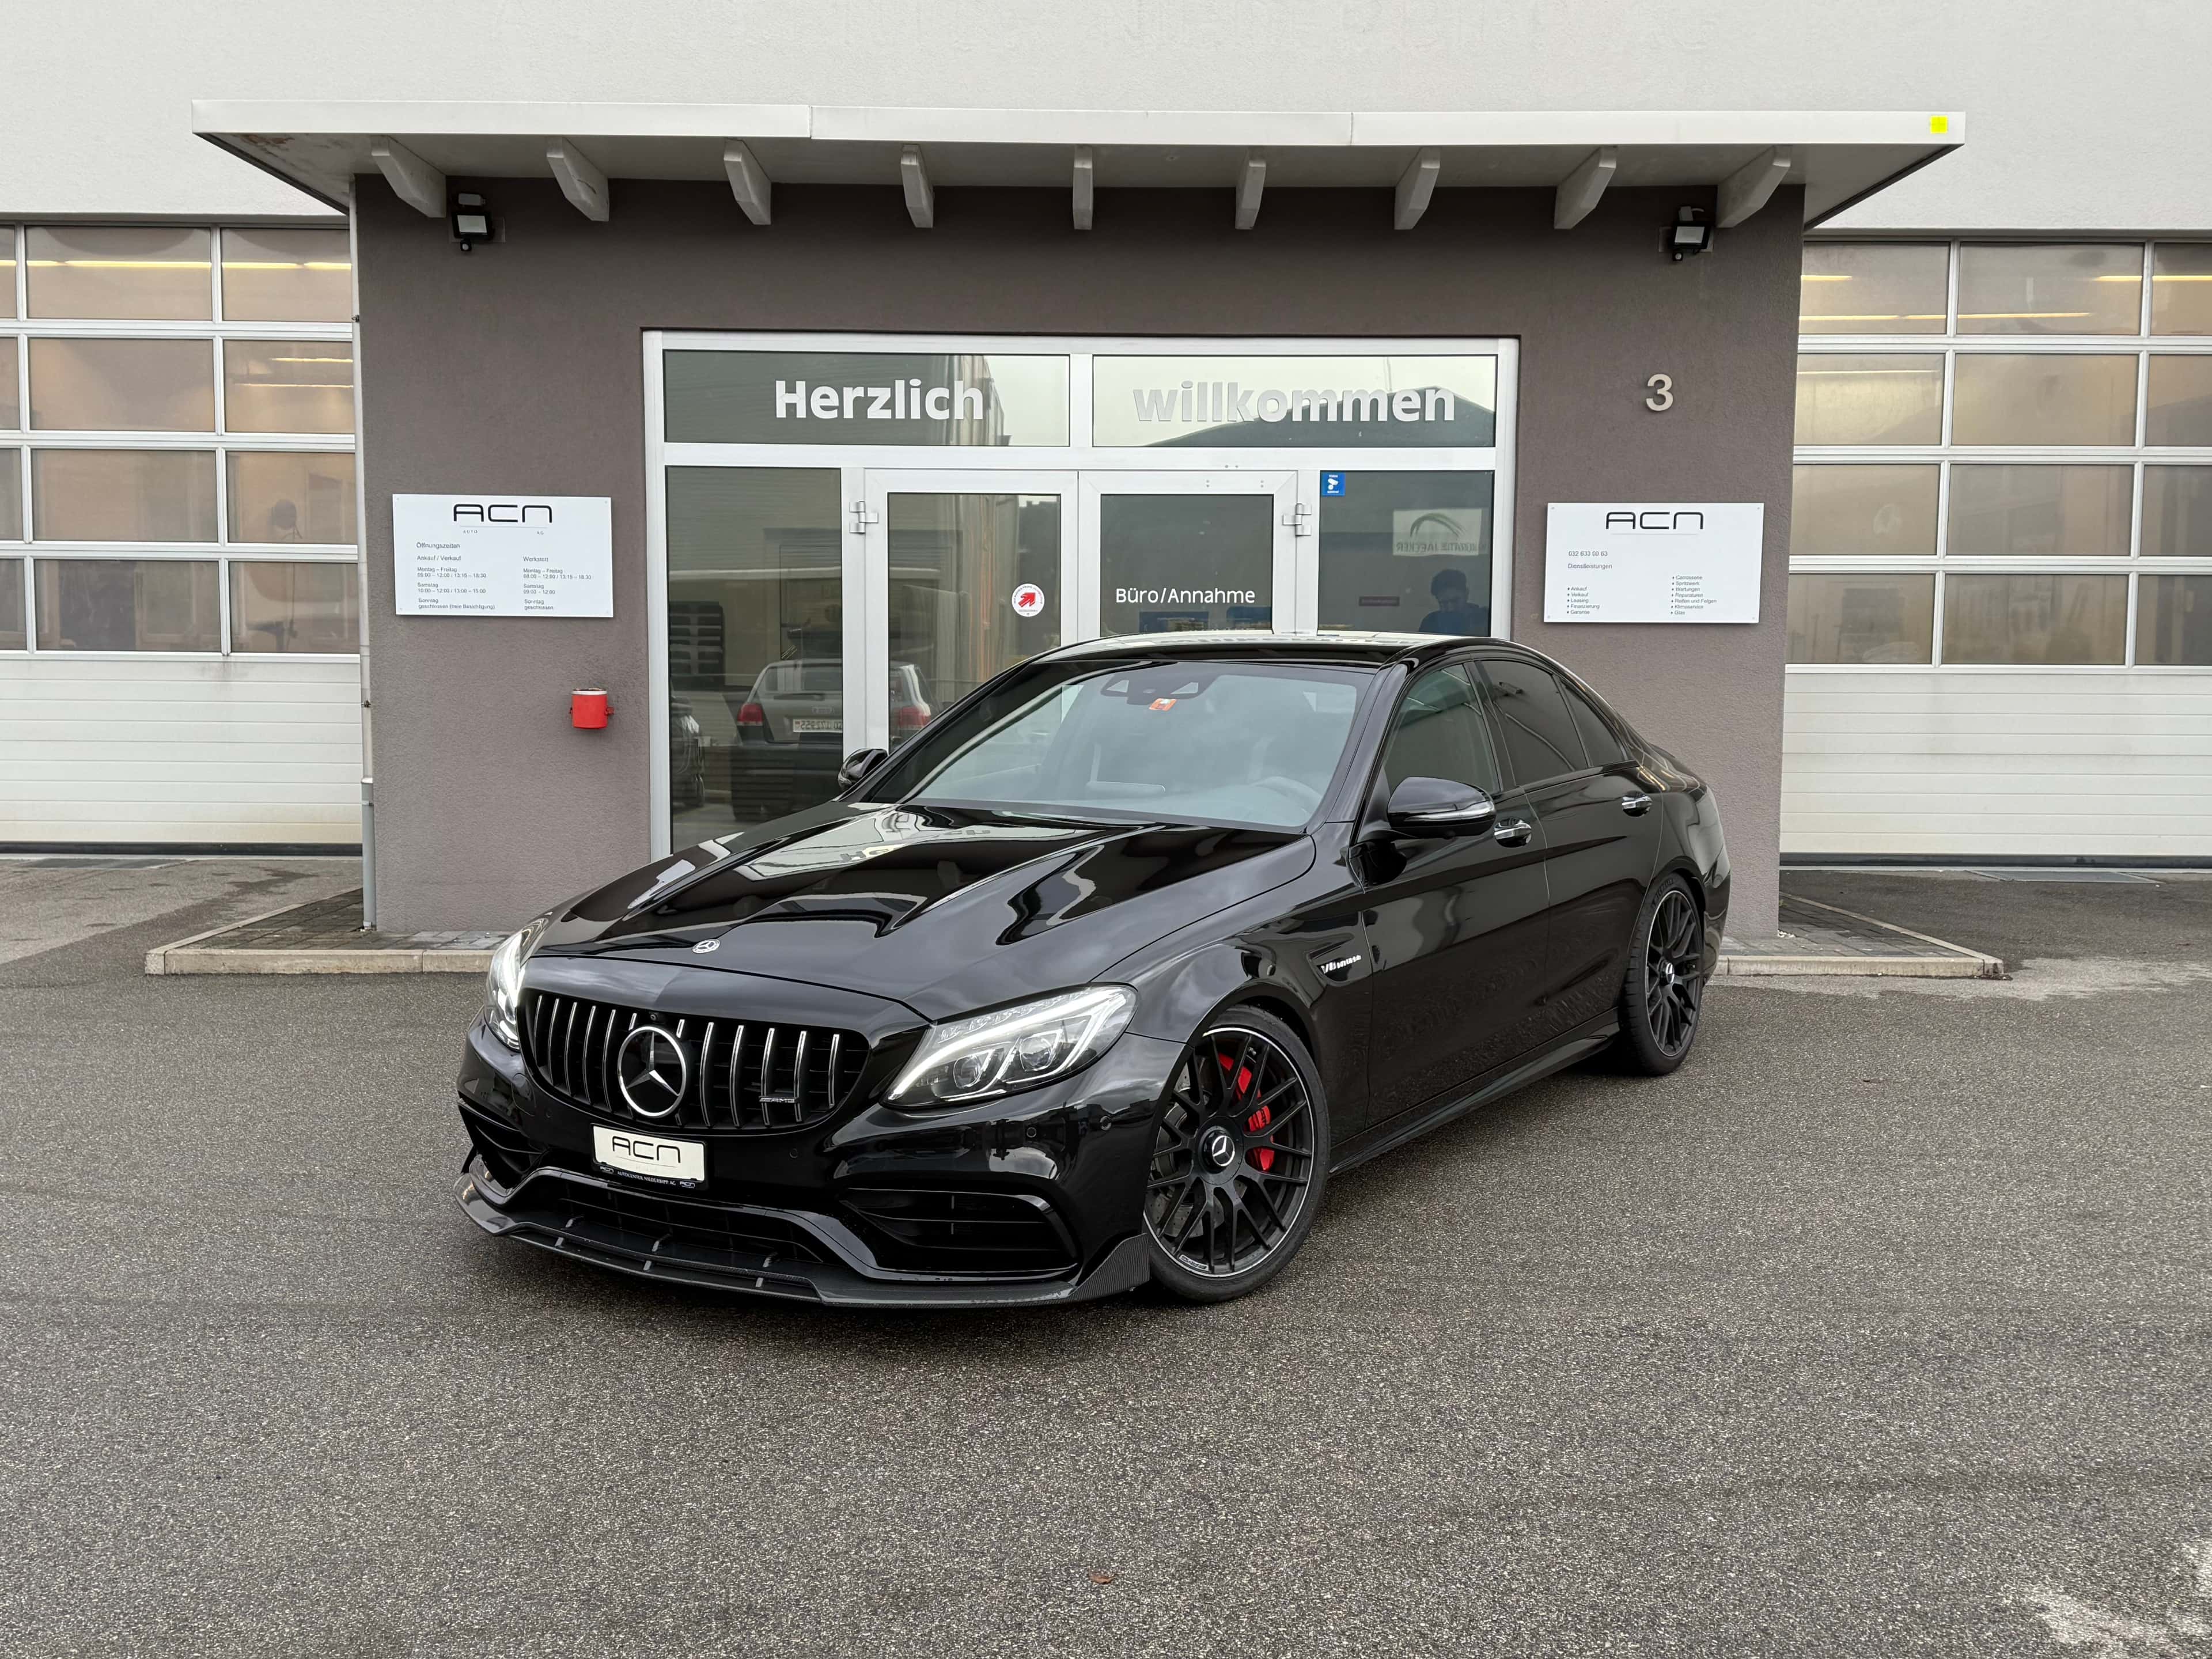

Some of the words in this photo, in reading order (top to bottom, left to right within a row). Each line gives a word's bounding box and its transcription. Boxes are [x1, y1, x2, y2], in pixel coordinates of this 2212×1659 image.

[775, 378, 983, 419] Herzlich
[1132, 380, 1455, 422] willkommen
[1646, 374, 1673, 411] 3
[1116, 588, 1255, 603] Büro/Annahme
